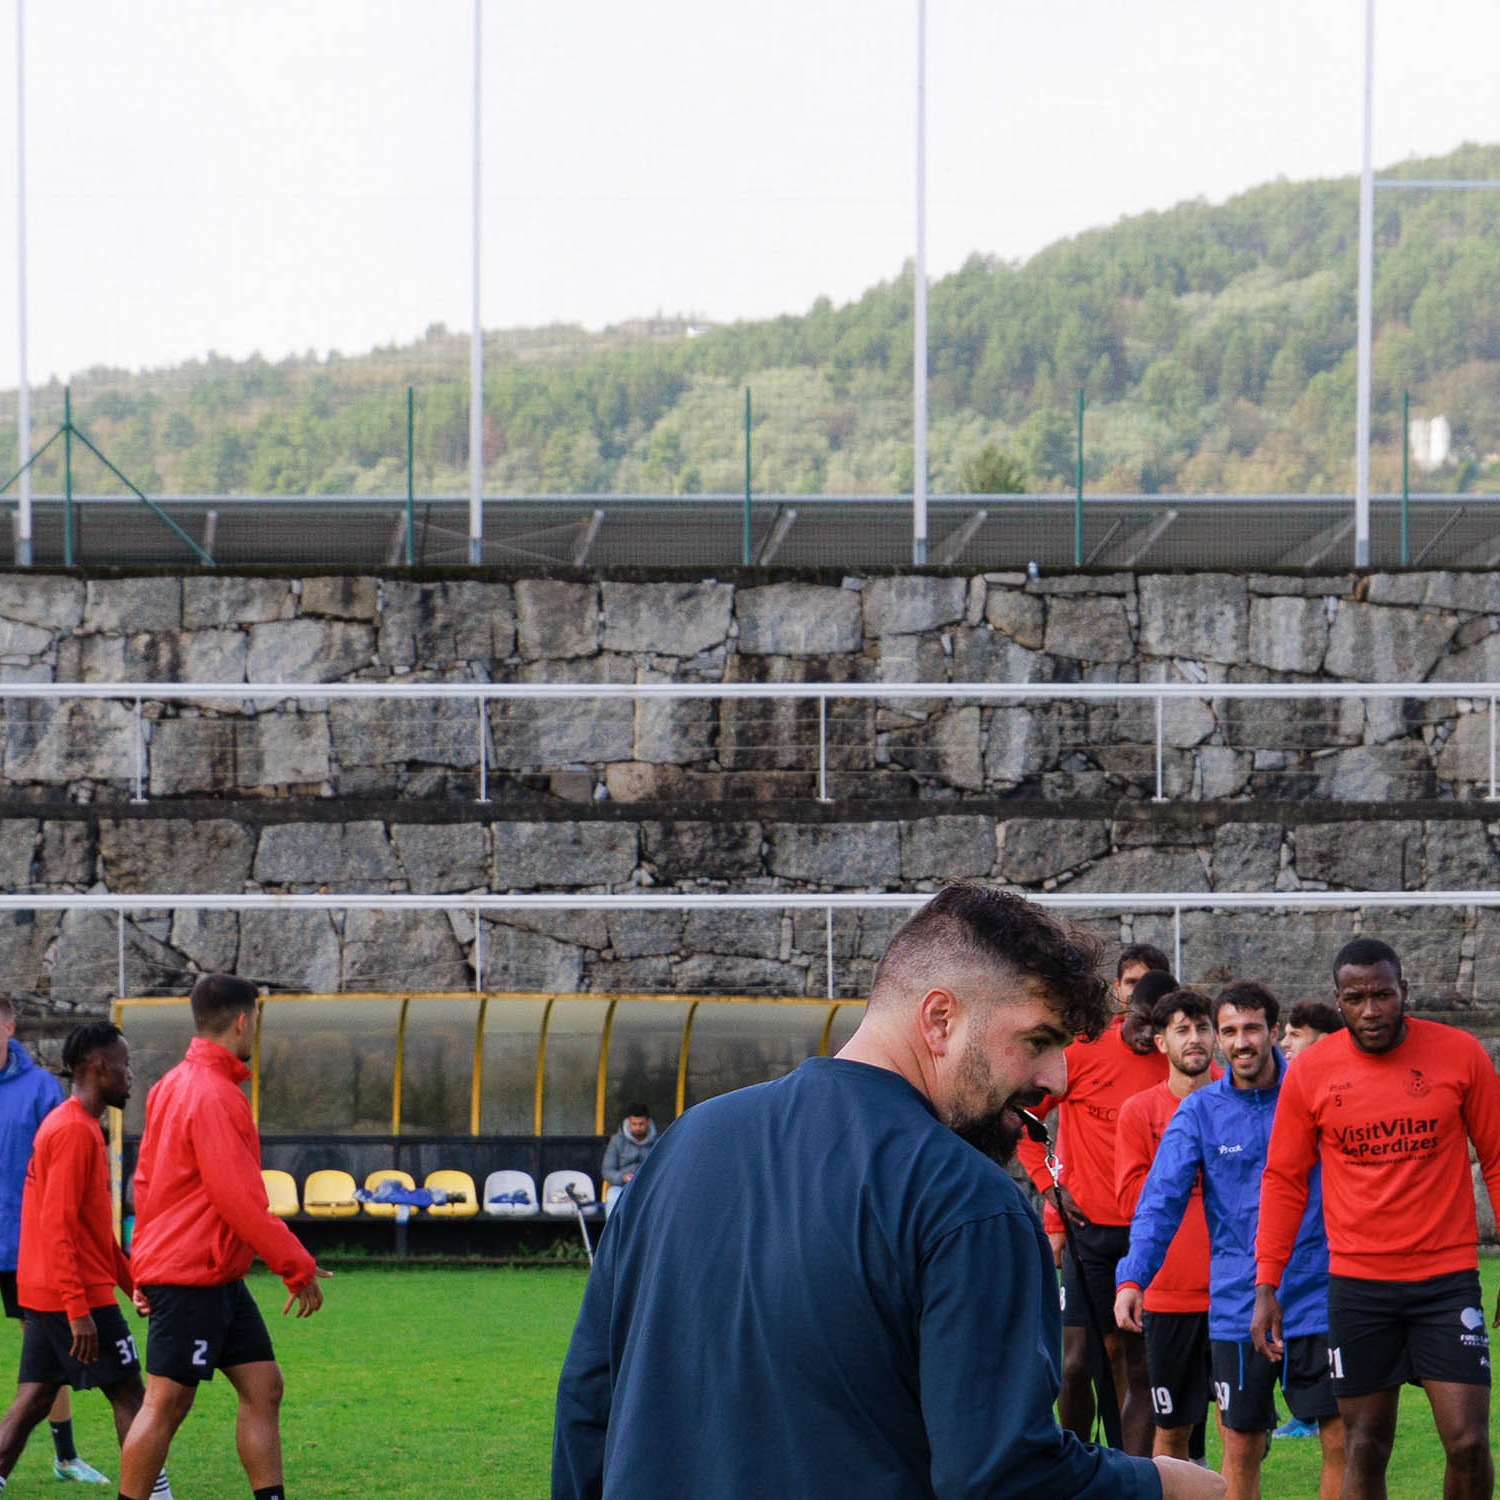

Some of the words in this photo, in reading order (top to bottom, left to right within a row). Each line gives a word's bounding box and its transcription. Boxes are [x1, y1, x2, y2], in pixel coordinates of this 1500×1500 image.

[1333, 1117, 1438, 1143] VisitVilar
[1341, 1136, 1437, 1157] dePerdizes
[192, 1340, 208, 1365] 2
[1151, 1386, 1173, 1414] 19
